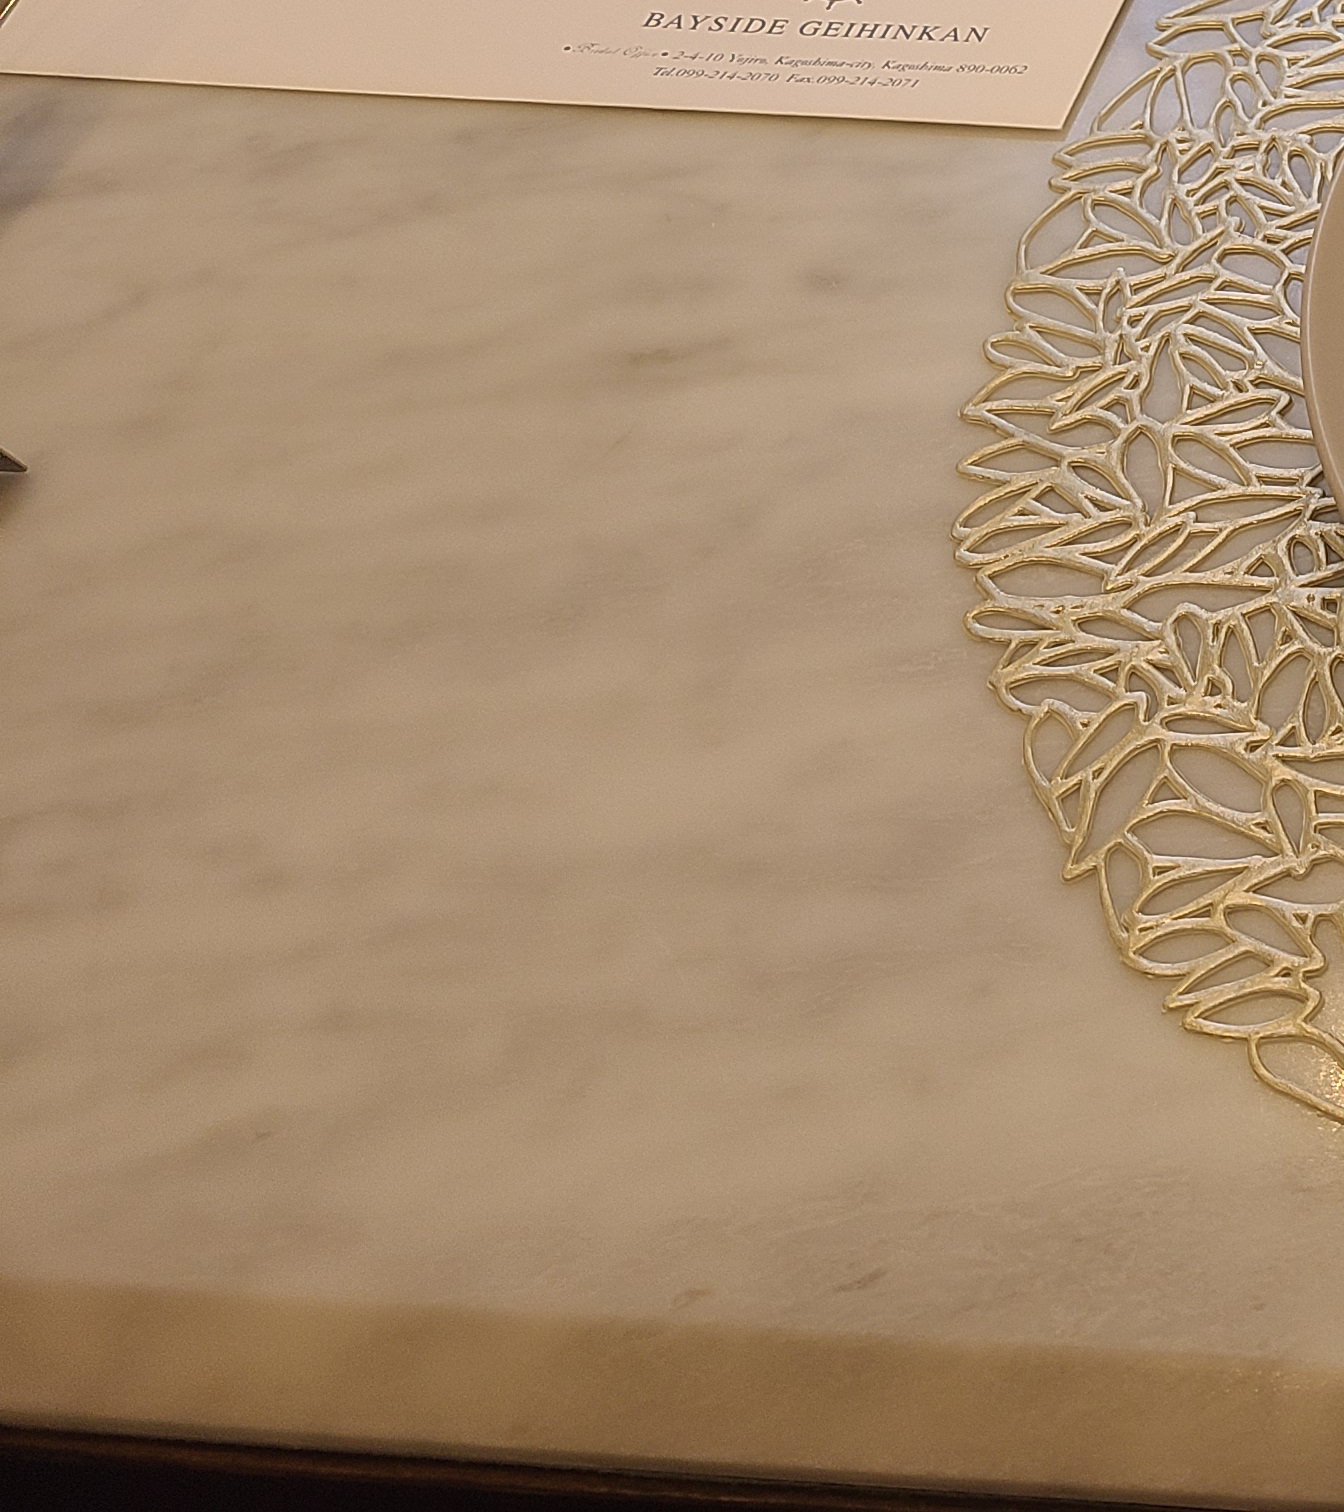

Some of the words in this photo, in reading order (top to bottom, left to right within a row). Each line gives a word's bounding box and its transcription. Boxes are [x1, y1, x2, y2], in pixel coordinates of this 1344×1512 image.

[642, 12, 789, 36] BAYSIDE
[799, 19, 990, 44] GEIHINKAN
[672, 50, 725, 63] 2-4-10
[880, 59, 953, 73] Kagoshima
[955, 63, 1029, 76] 890-0062
[652, 66, 780, 83] Tel.099-214-2070
[785, 73, 921, 89] Fax.099-214-2071
